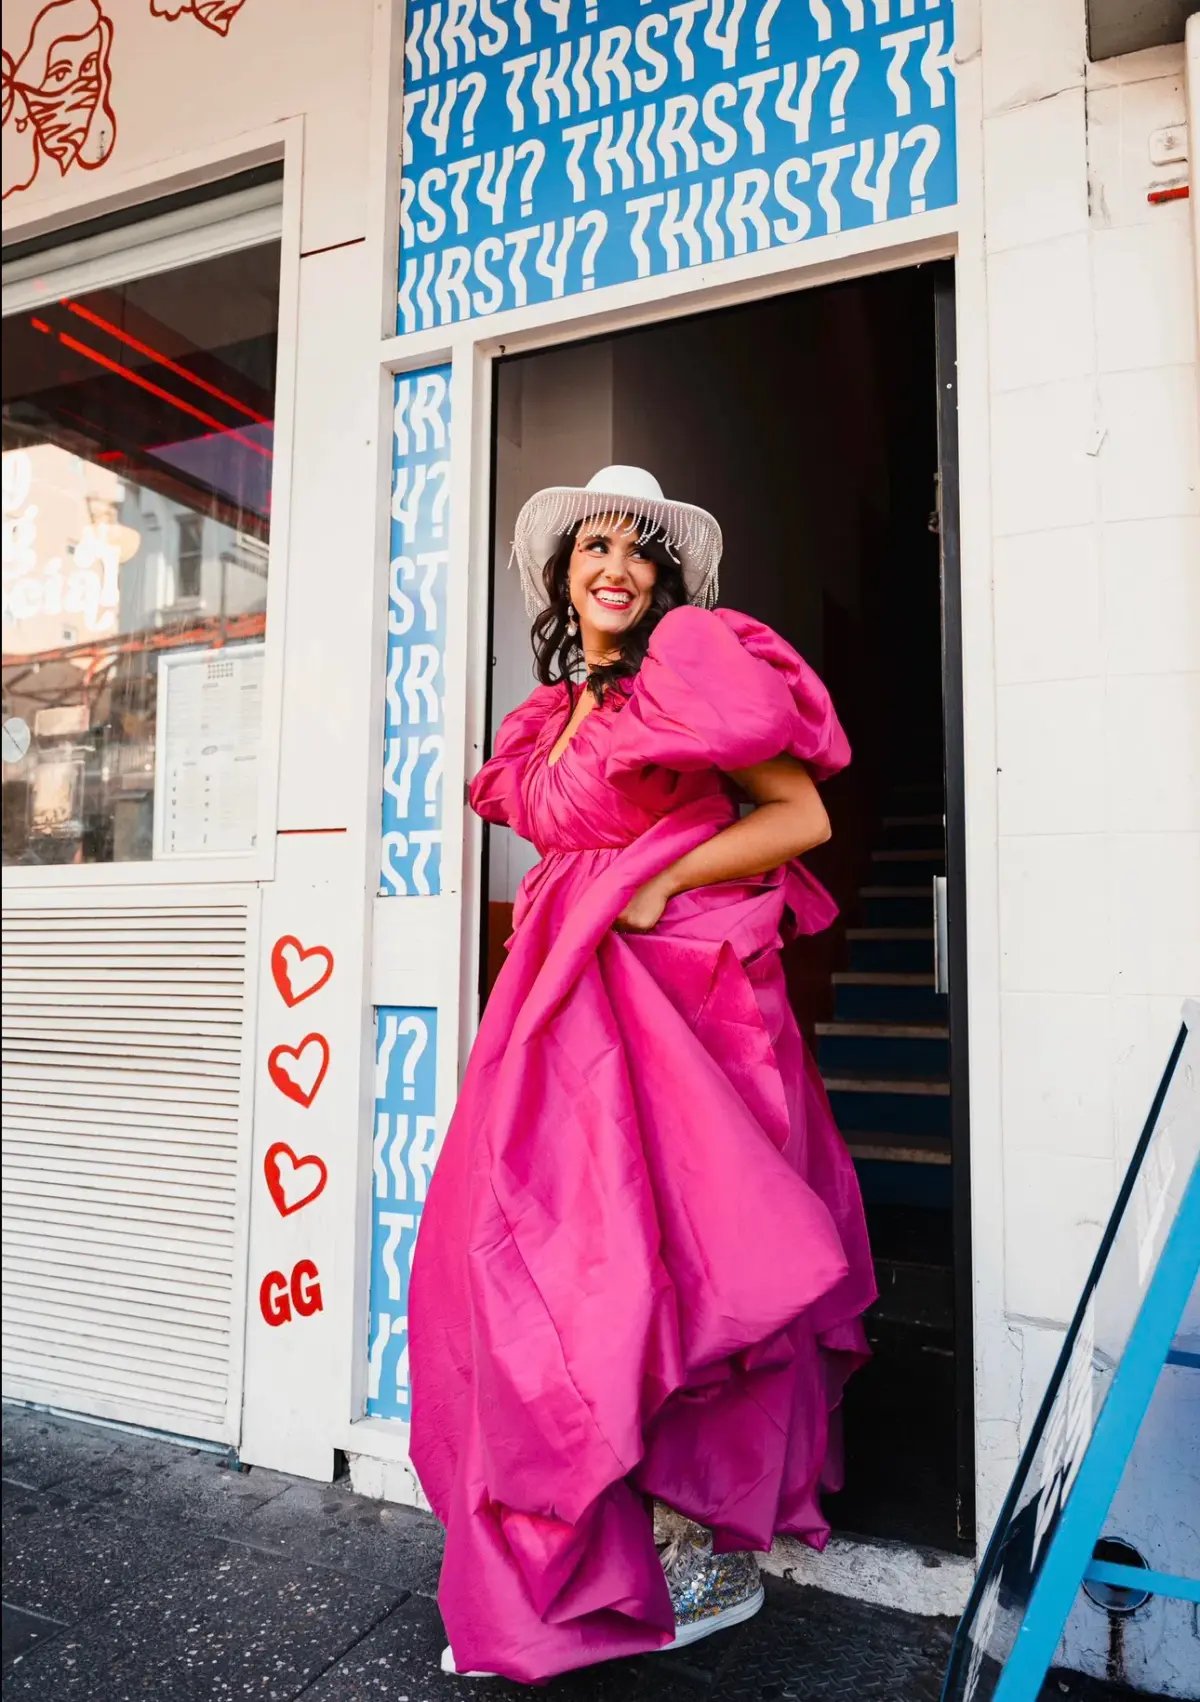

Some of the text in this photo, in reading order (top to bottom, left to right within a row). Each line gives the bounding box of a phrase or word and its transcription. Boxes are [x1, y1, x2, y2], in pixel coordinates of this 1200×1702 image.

[502, 0, 782, 133] THIRSTY?
[562, 47, 860, 203] THIRSTY?
[626, 124, 941, 279] THIRSTY?
[259, 1259, 324, 1328] GG
